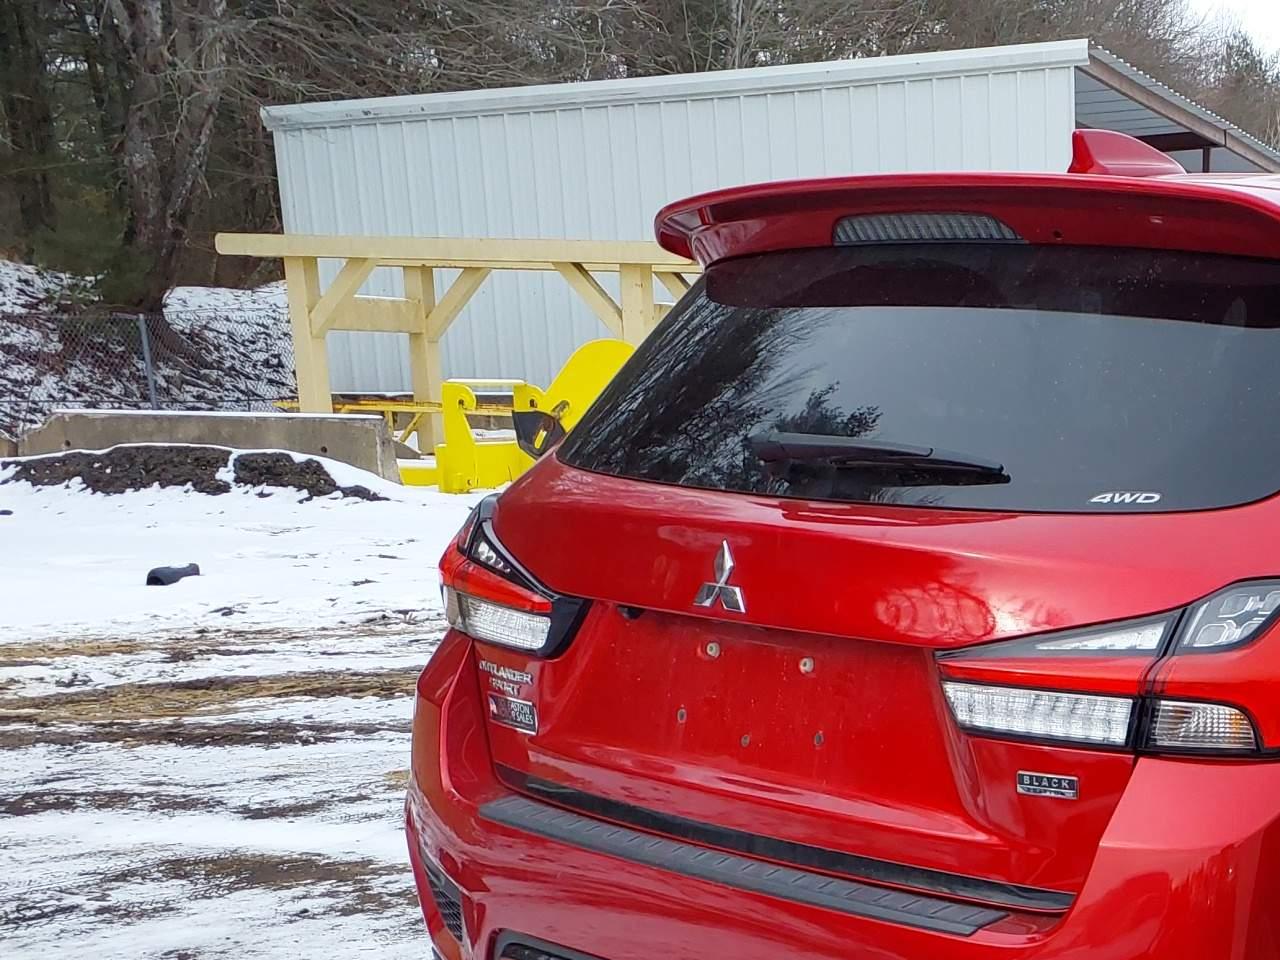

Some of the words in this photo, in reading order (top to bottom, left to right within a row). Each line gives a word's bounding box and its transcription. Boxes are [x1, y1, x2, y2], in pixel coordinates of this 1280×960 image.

[1090, 492, 1161, 504] 4WD
[479, 660, 533, 684] OUTLANDER
[1023, 775, 1070, 789] BLACK
